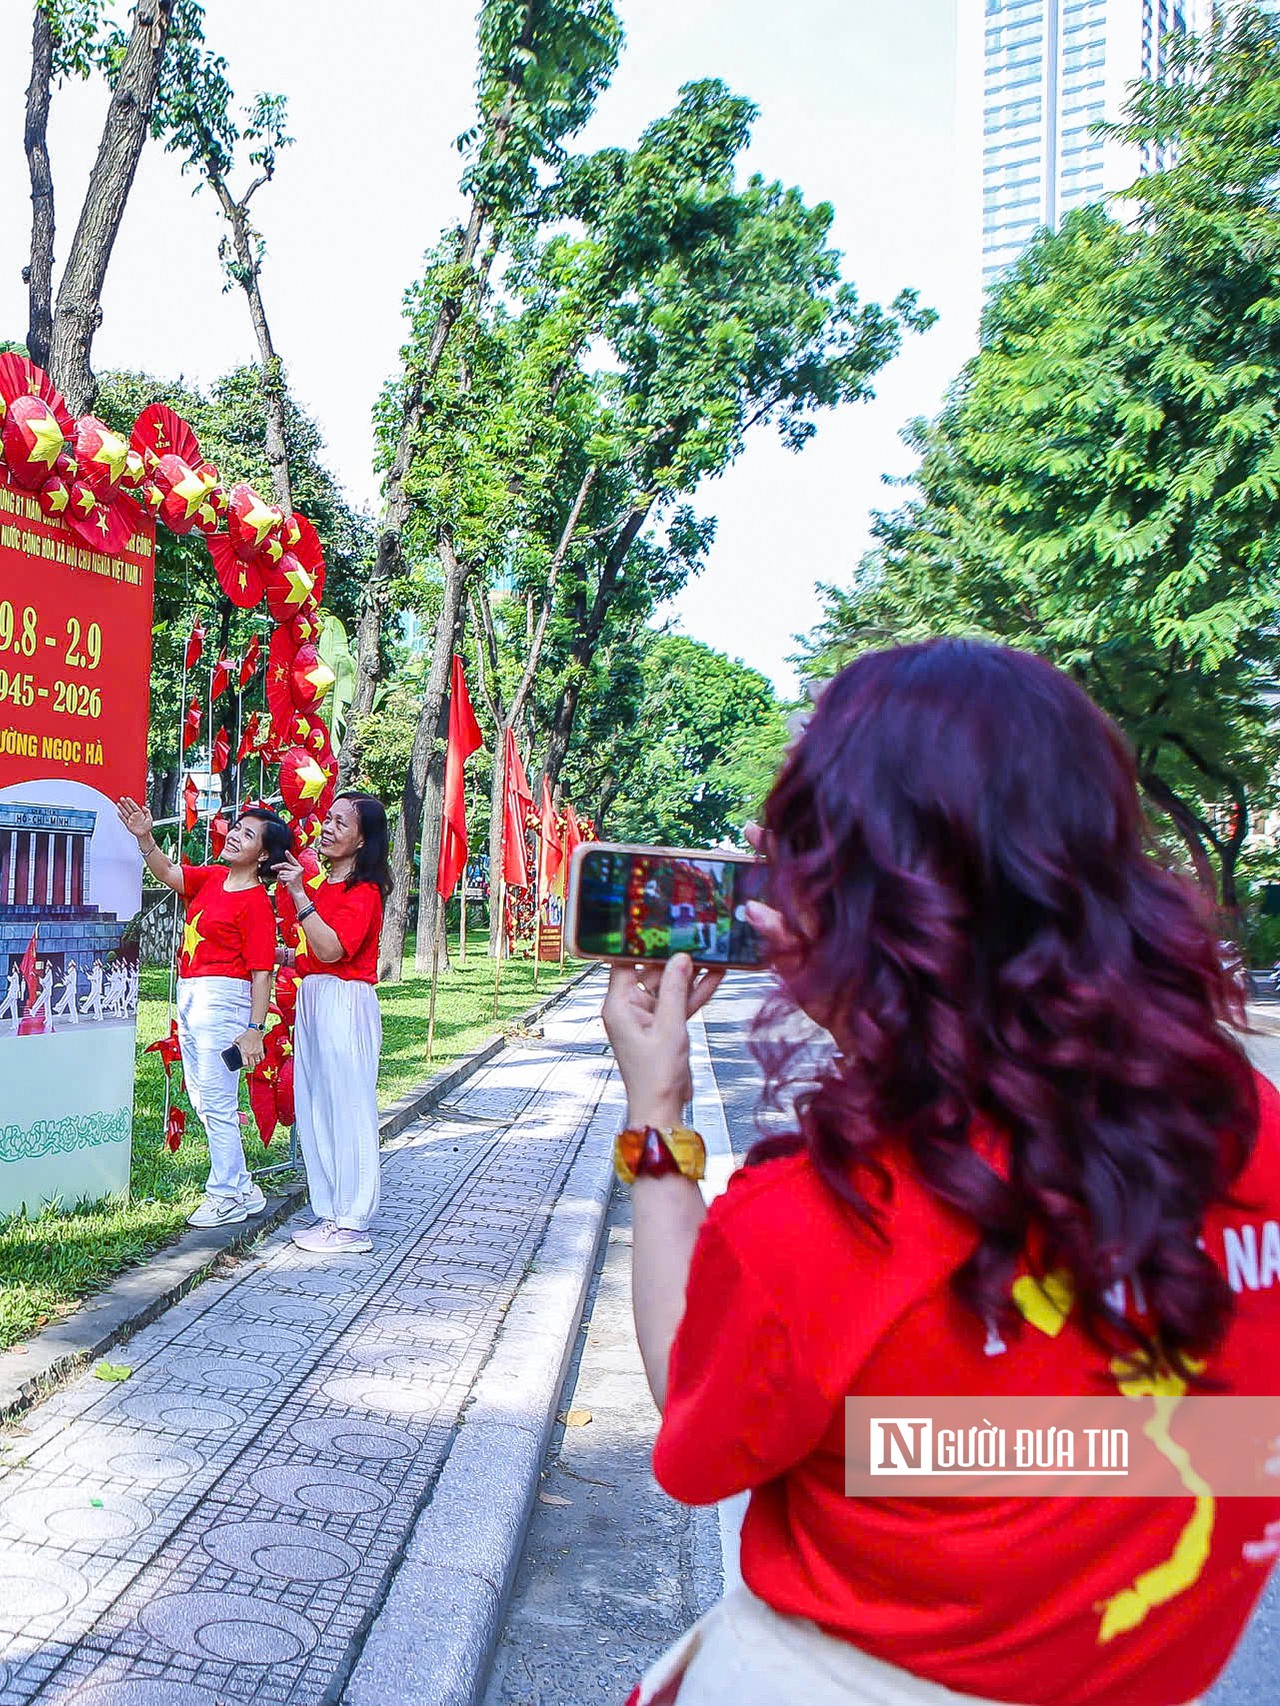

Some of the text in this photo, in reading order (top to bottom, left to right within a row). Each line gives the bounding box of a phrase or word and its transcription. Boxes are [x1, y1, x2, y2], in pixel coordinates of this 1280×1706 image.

[16, 495, 24, 517] 81
[1, 522, 21, 551] NƯỚC
[21, 528, 41, 558] CỘNG
[56, 539, 66, 564] XÃ
[66, 542, 77, 571] HỘI
[111, 556, 125, 584] VIỆT
[124, 562, 139, 586] NAM
[64, 617, 102, 670] 2.9
[41, 736, 81, 767] NGỌC
[85, 739, 104, 767] HÀ
